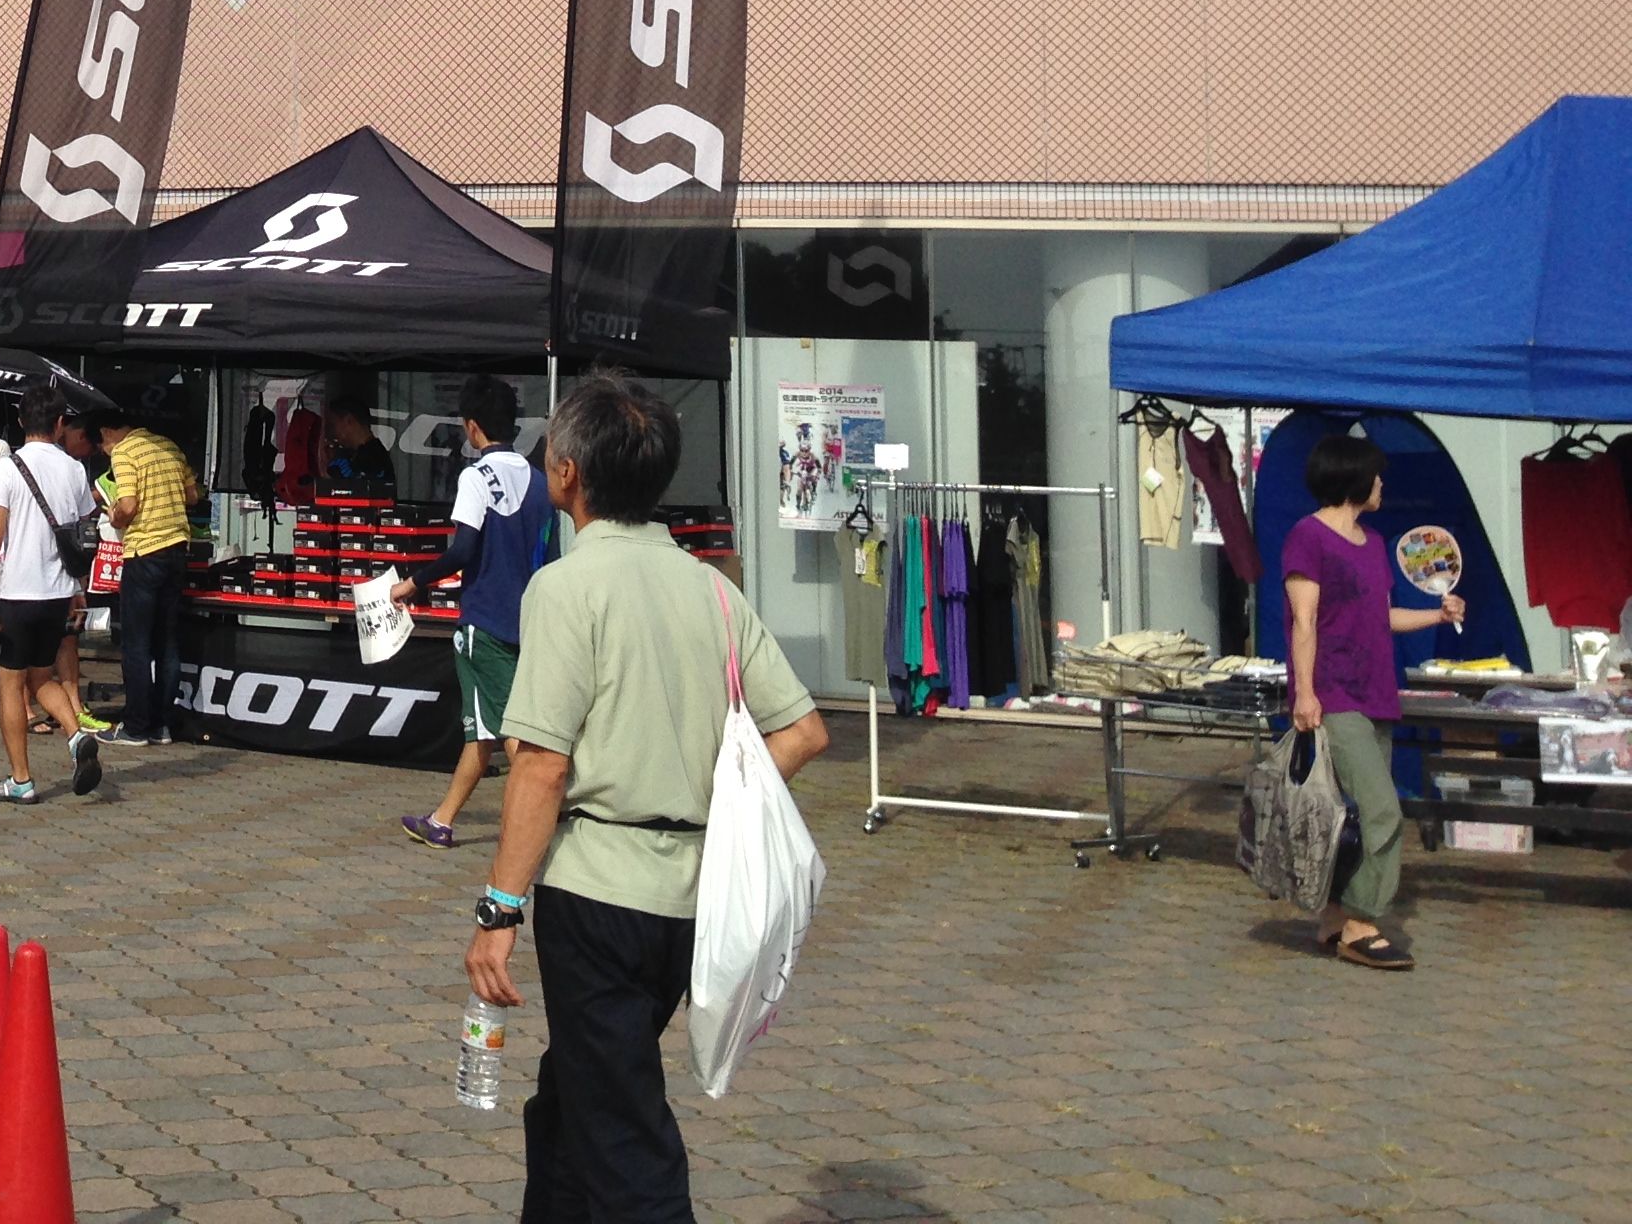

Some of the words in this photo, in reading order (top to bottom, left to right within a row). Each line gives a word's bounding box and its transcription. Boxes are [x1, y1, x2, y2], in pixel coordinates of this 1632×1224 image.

[142, 255, 409, 277] SCOTT
[29, 302, 214, 327] SCOTT
[819, 387, 844, 395] 2014
